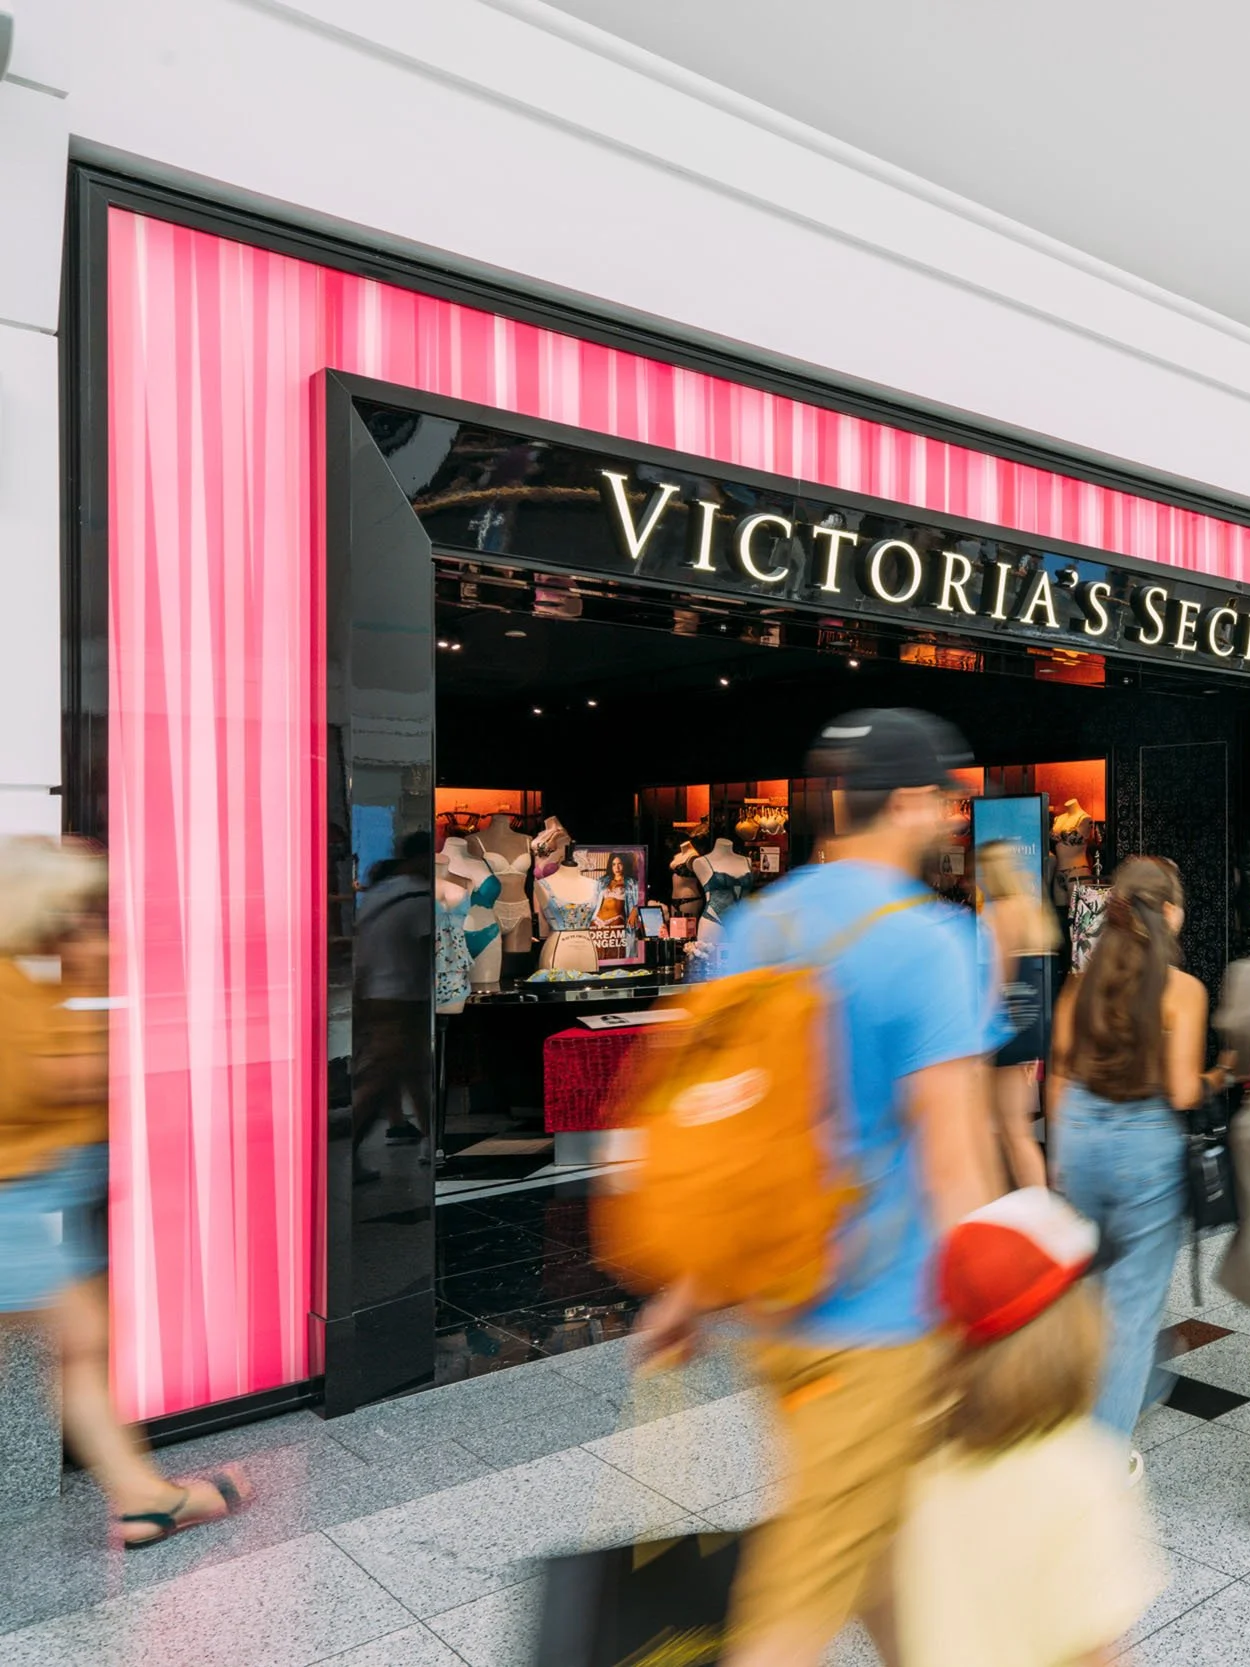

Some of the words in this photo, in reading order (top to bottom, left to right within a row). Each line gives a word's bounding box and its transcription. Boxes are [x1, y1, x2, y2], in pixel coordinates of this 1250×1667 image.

[601, 470, 1112, 636] VICTORIA'S
[589, 929, 626, 940] DREAM
[593, 938, 628, 948] NGELS
